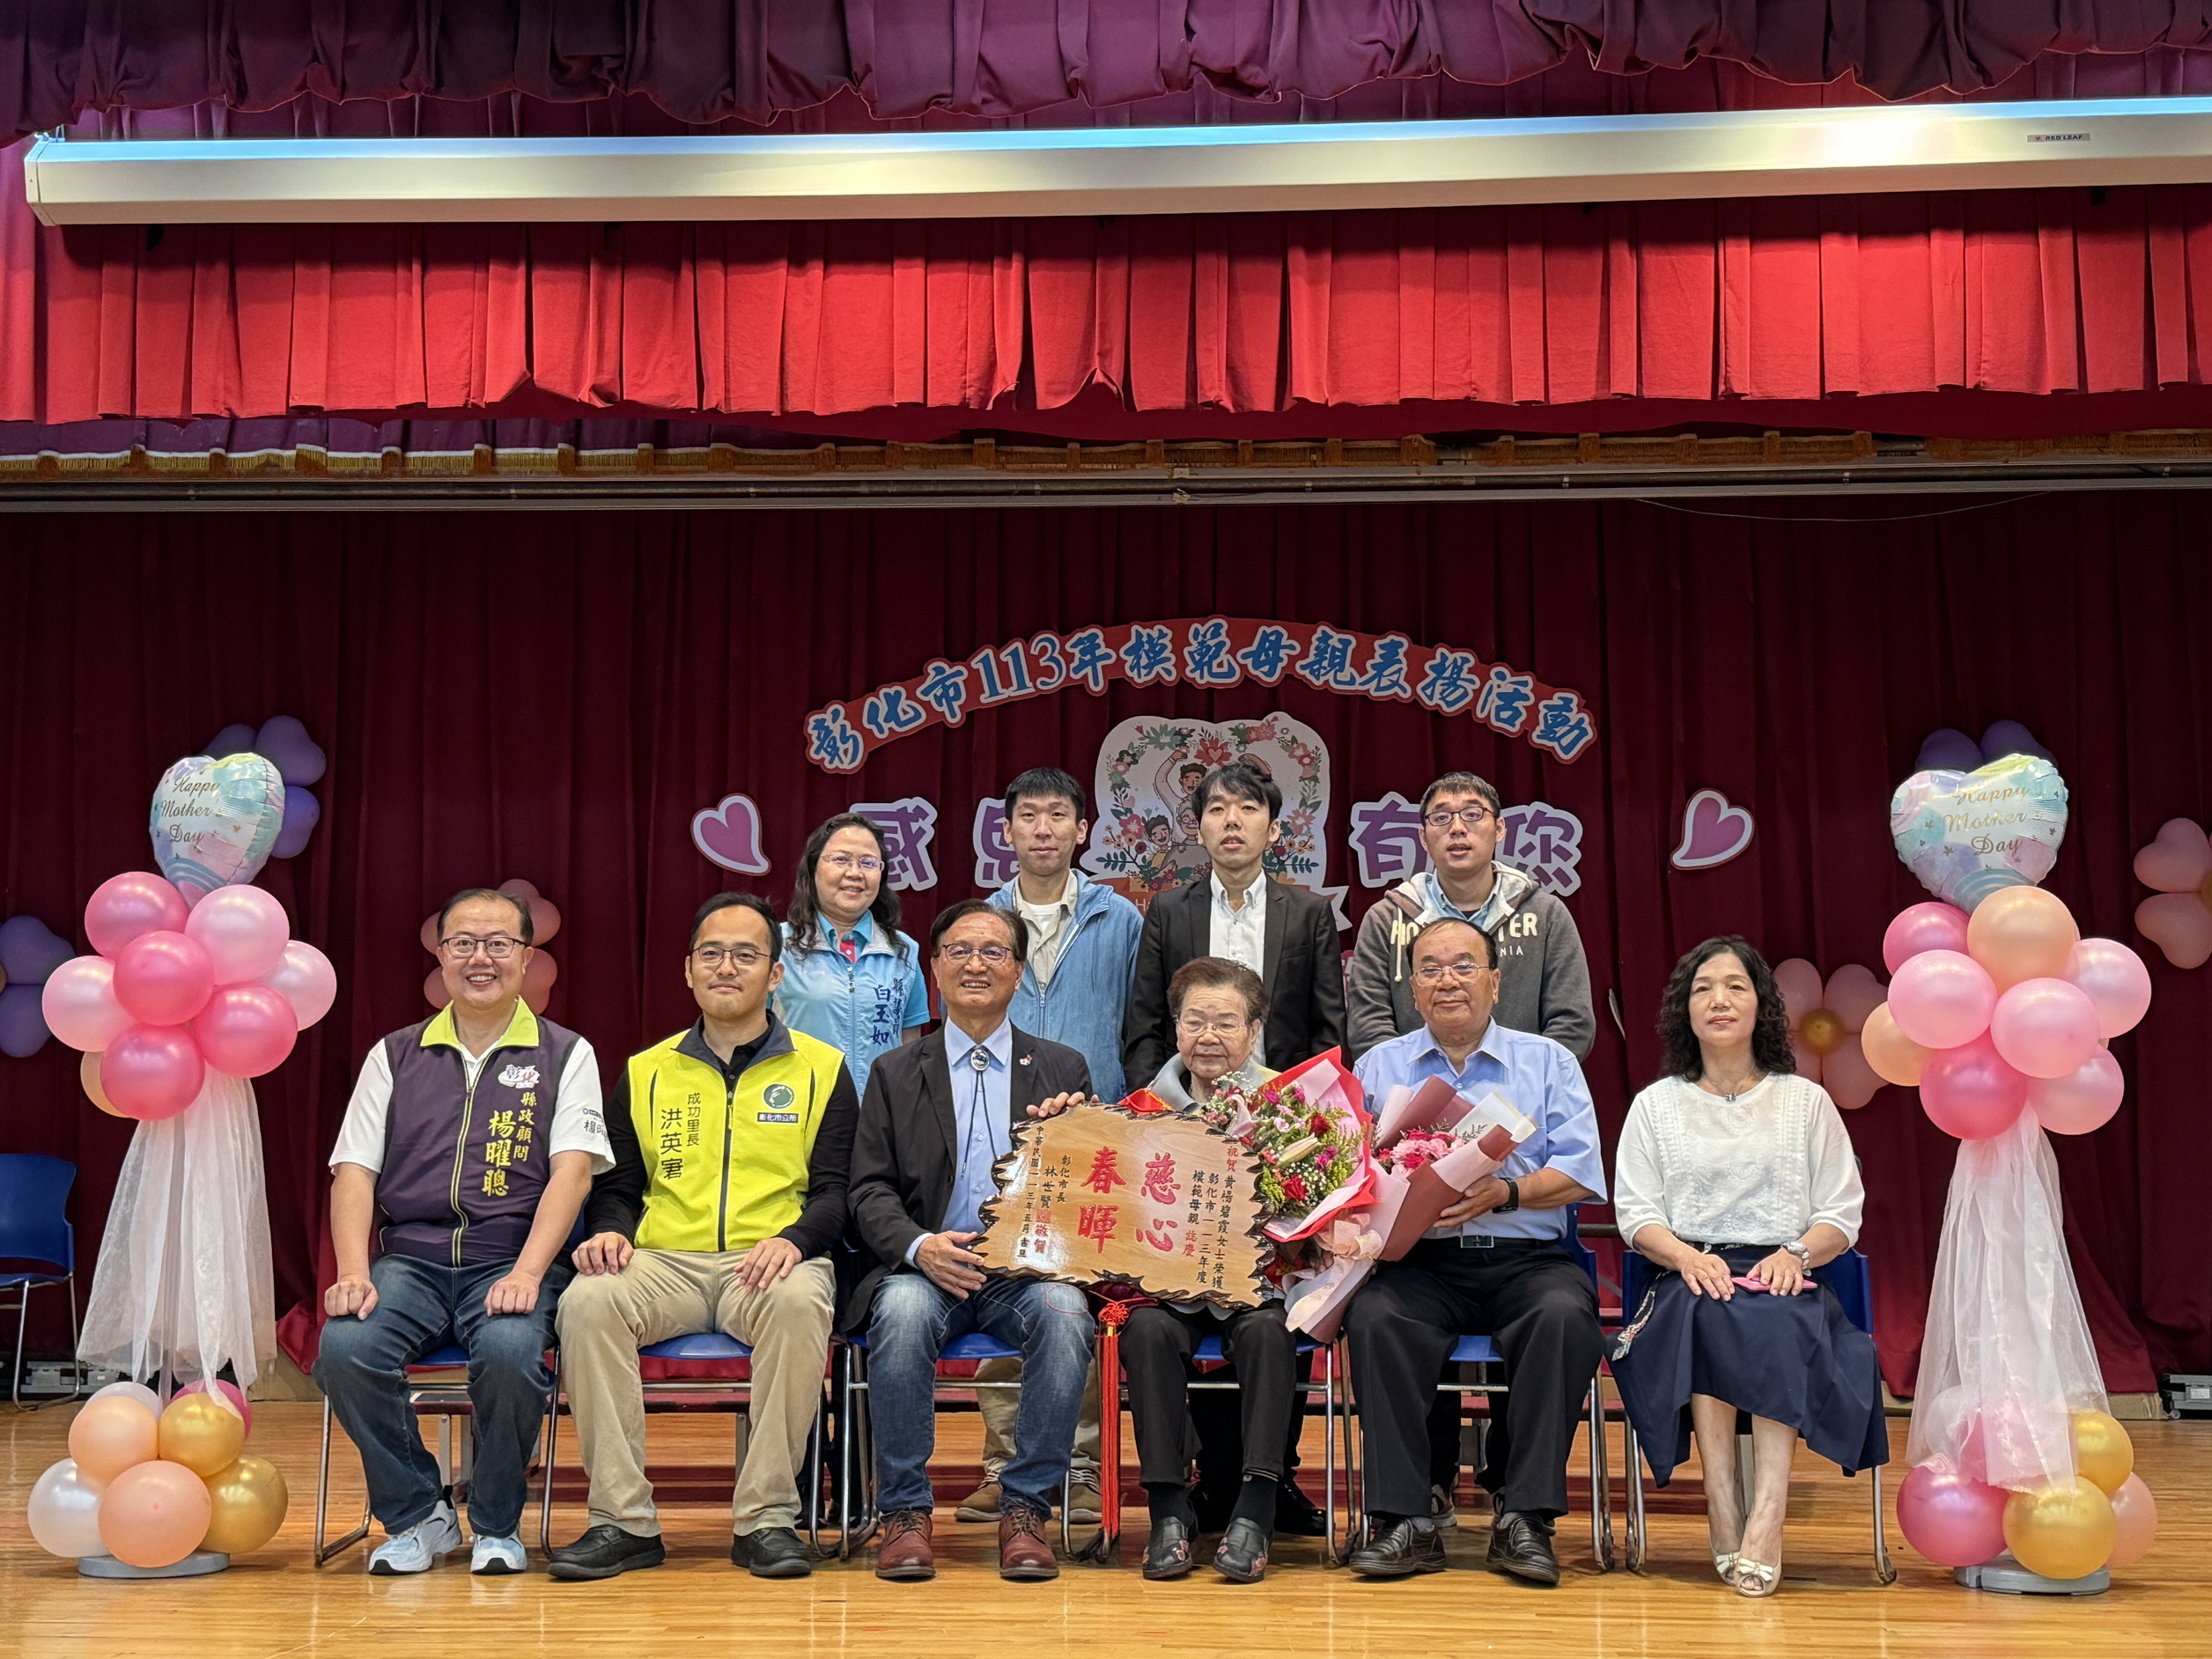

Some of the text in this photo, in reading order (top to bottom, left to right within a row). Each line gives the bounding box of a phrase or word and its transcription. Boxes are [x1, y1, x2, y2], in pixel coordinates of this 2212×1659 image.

[808, 620, 1590, 766] 彰化市113年模範母親表揚活動
[161, 798, 212, 817] Mother
[173, 776, 221, 797] Happy
[1954, 785, 2031, 805] Happy
[170, 823, 204, 843] Day
[1943, 812, 2028, 833] Mother
[1971, 834, 2023, 856] Day
[870, 984, 891, 1046] 白玉如
[513, 1091, 537, 1162] 縣政顧問
[687, 1092, 702, 1147] 成功里長
[482, 1110, 517, 1198] 楊曜聰
[1056, 1154, 1072, 1203] 彰化市長
[1135, 1152, 1182, 1252] 慈心
[1196, 1172, 1220, 1284] 彰化市一一三年度
